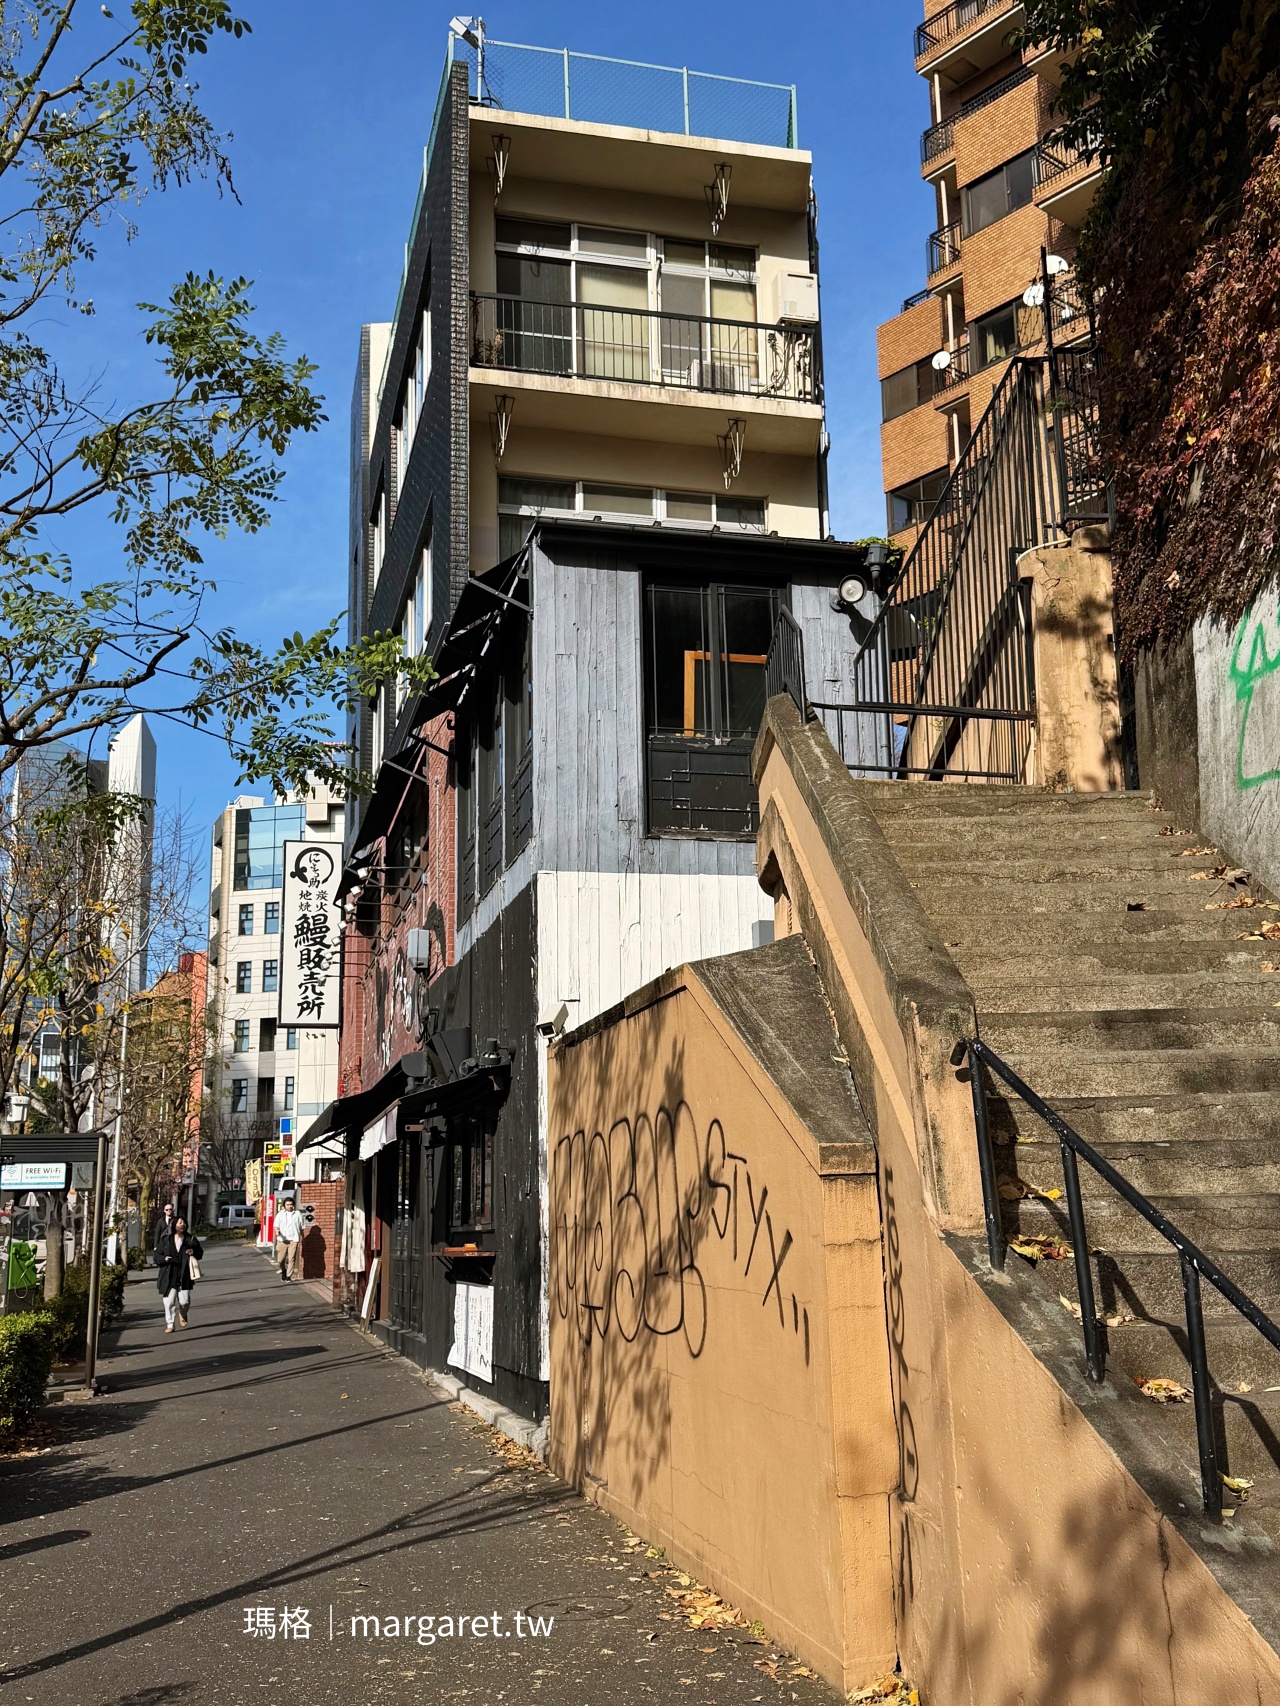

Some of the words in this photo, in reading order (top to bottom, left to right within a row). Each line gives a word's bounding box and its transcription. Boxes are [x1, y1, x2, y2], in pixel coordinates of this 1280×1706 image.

[315, 890, 329, 913] 炭火
[294, 913, 332, 1021] 鰻販売所
